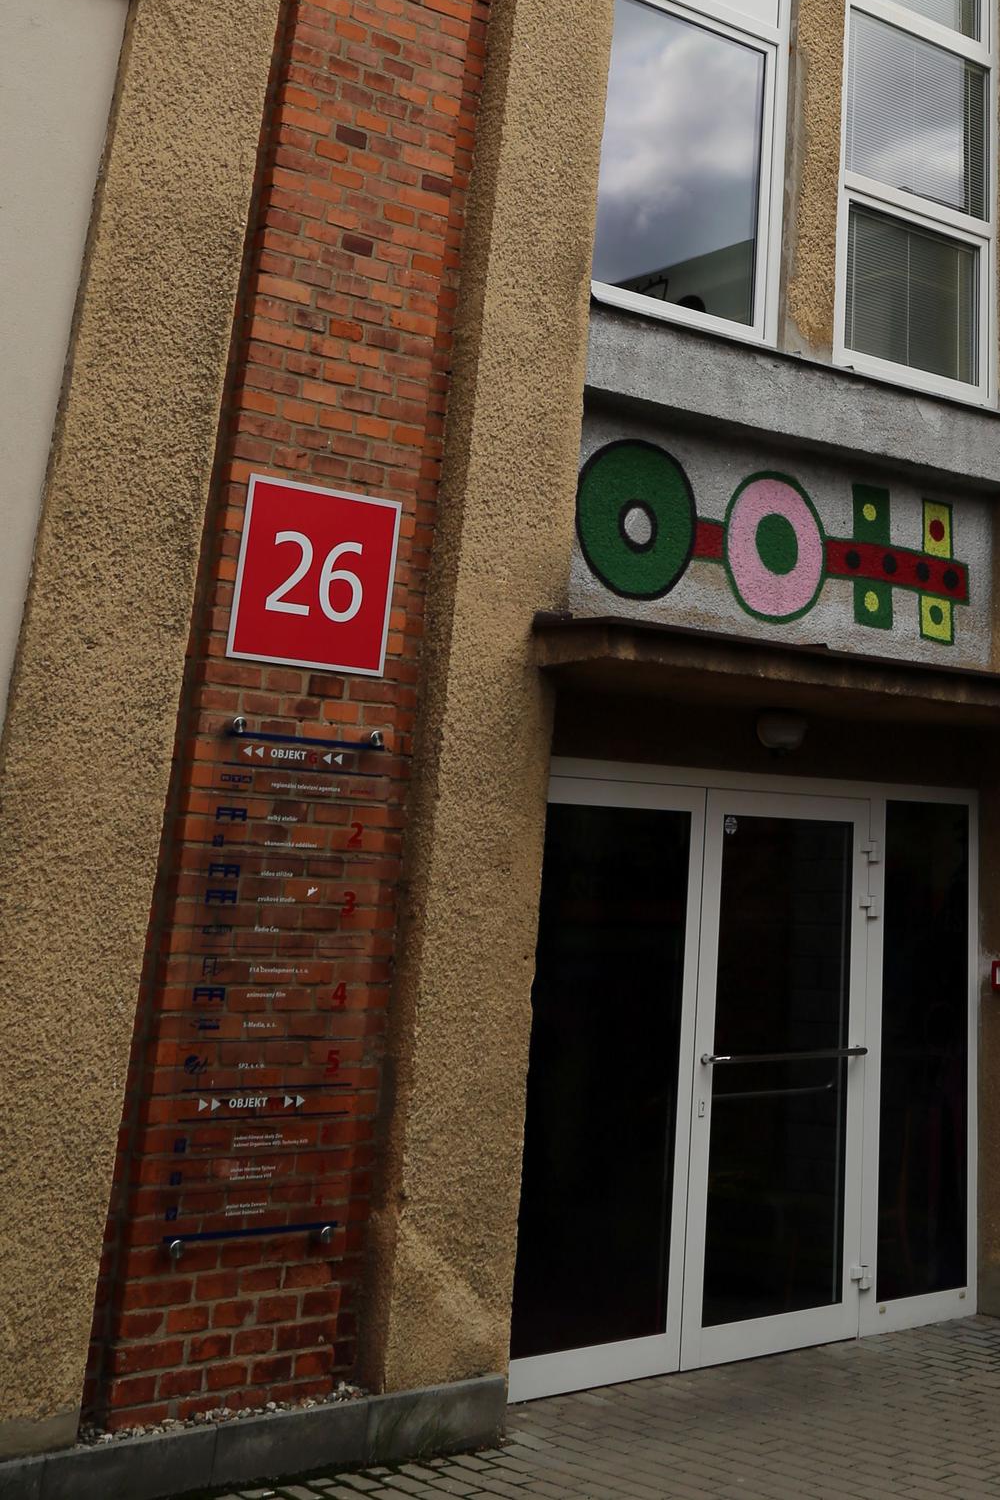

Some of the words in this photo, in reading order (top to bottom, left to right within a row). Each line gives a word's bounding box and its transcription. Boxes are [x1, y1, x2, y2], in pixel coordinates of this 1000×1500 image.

[265, 531, 363, 622] 26
[270, 748, 307, 761] OBJEKT
[348, 822, 363, 846] 2
[341, 891, 356, 915] 3
[332, 982, 347, 1005] 4
[326, 1050, 340, 1073] 5
[228, 1096, 269, 1109] OBJEKT
